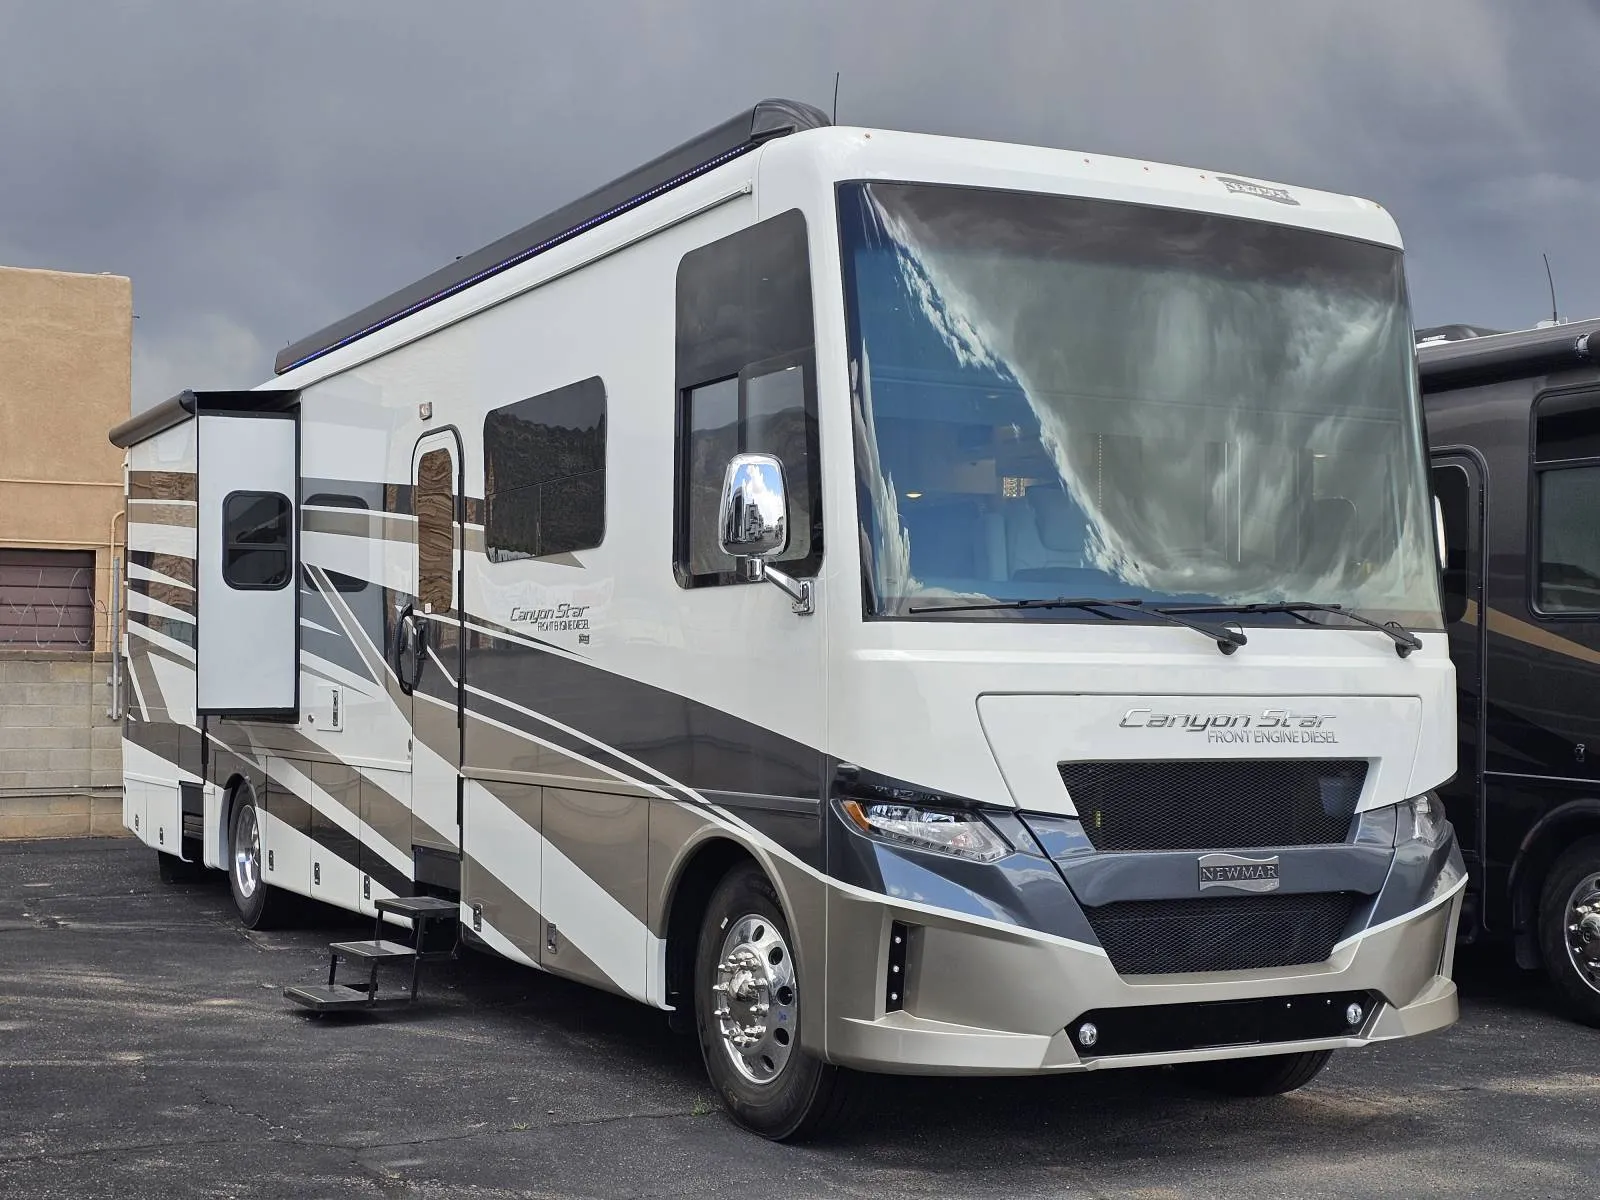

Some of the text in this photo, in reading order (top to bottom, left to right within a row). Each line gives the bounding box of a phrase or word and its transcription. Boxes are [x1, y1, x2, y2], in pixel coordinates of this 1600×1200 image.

[510, 603, 590, 624] Canyon Star
[1118, 708, 1337, 733] Canyon Star
[1207, 730, 1339, 744] FRONT ENGINE DIESEL
[1202, 866, 1278, 880] NEWMAR
